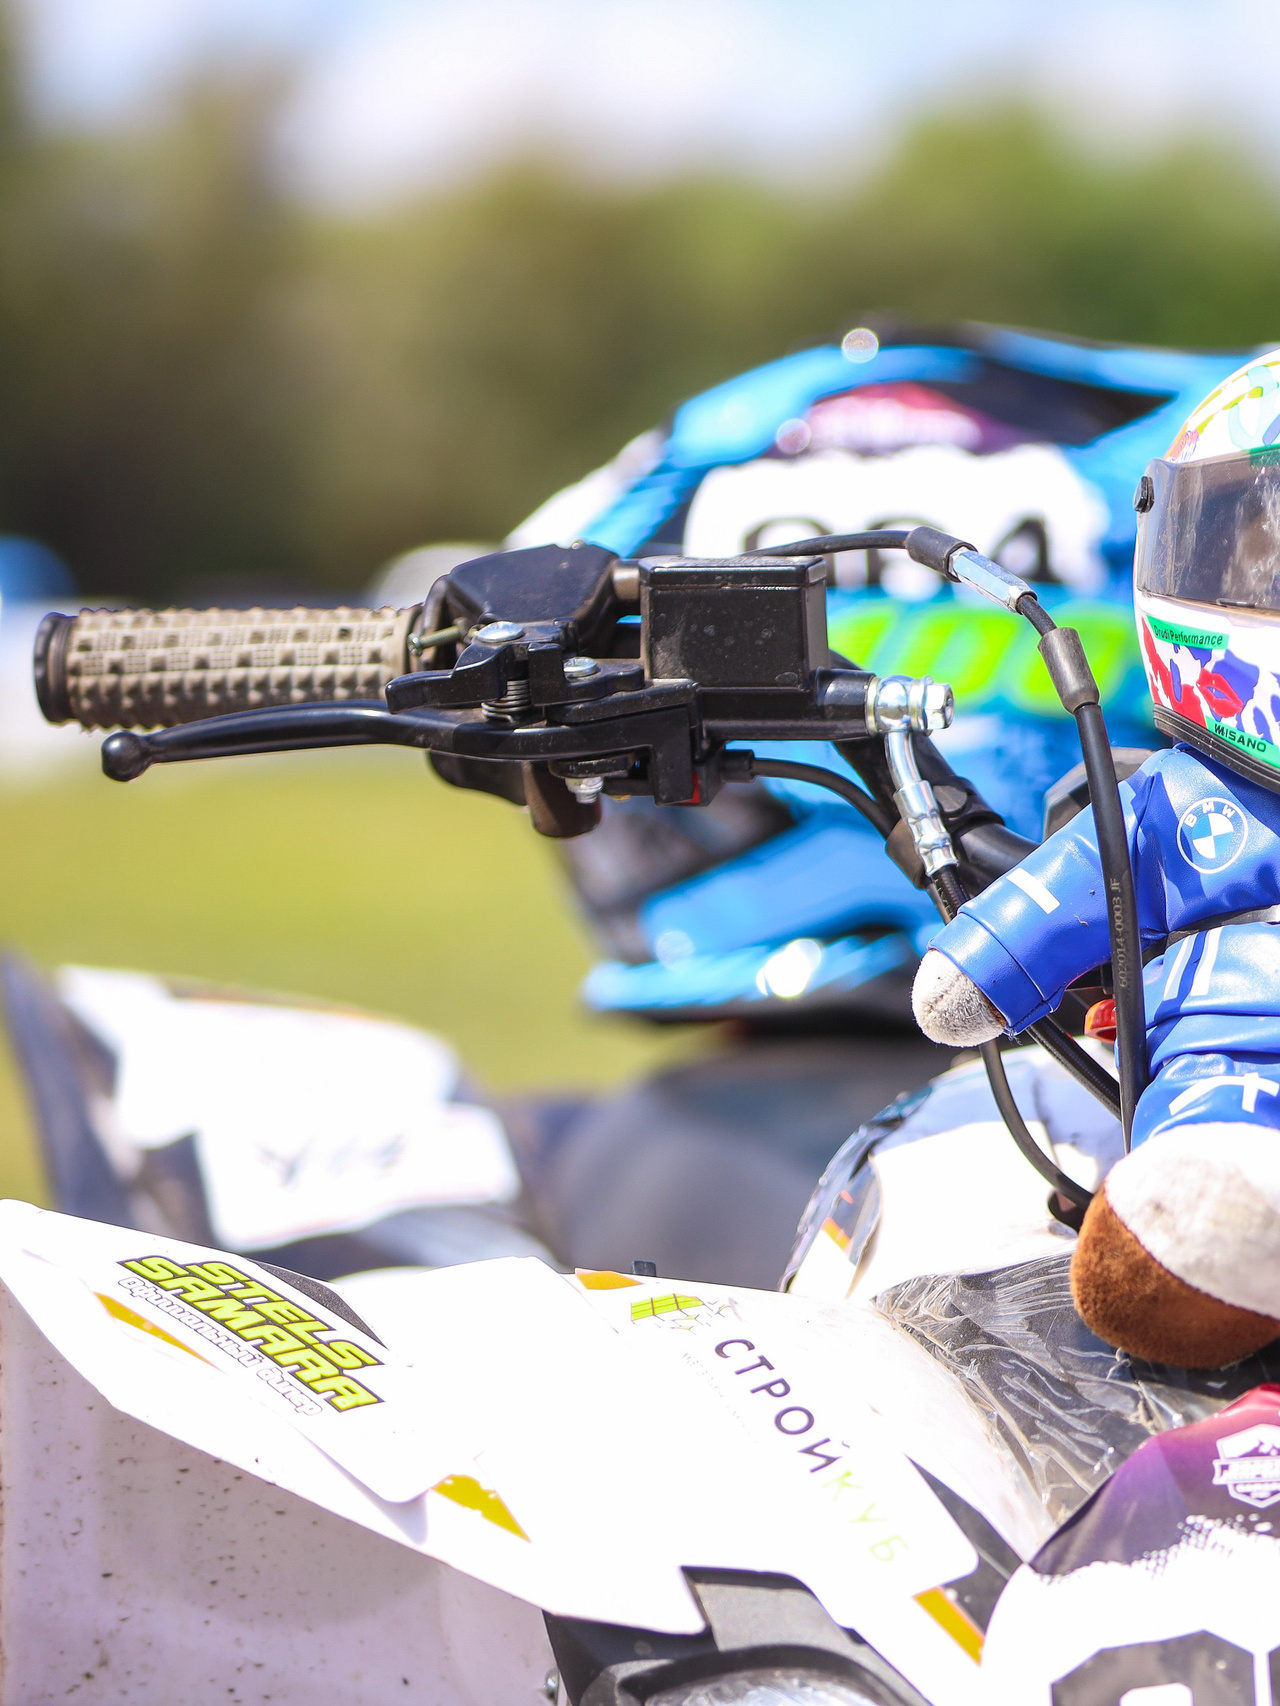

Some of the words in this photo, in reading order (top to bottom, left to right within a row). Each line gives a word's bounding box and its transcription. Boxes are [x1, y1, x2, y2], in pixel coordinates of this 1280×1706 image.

[1170, 630, 1223, 646] Performance
[1183, 800, 1236, 828] BMW
[1110, 878, 1120, 892] JF
[1112, 896, 1128, 988] 602014-0003
[116, 1255, 385, 1412] SAMARA
[185, 1261, 385, 1371] STELS
